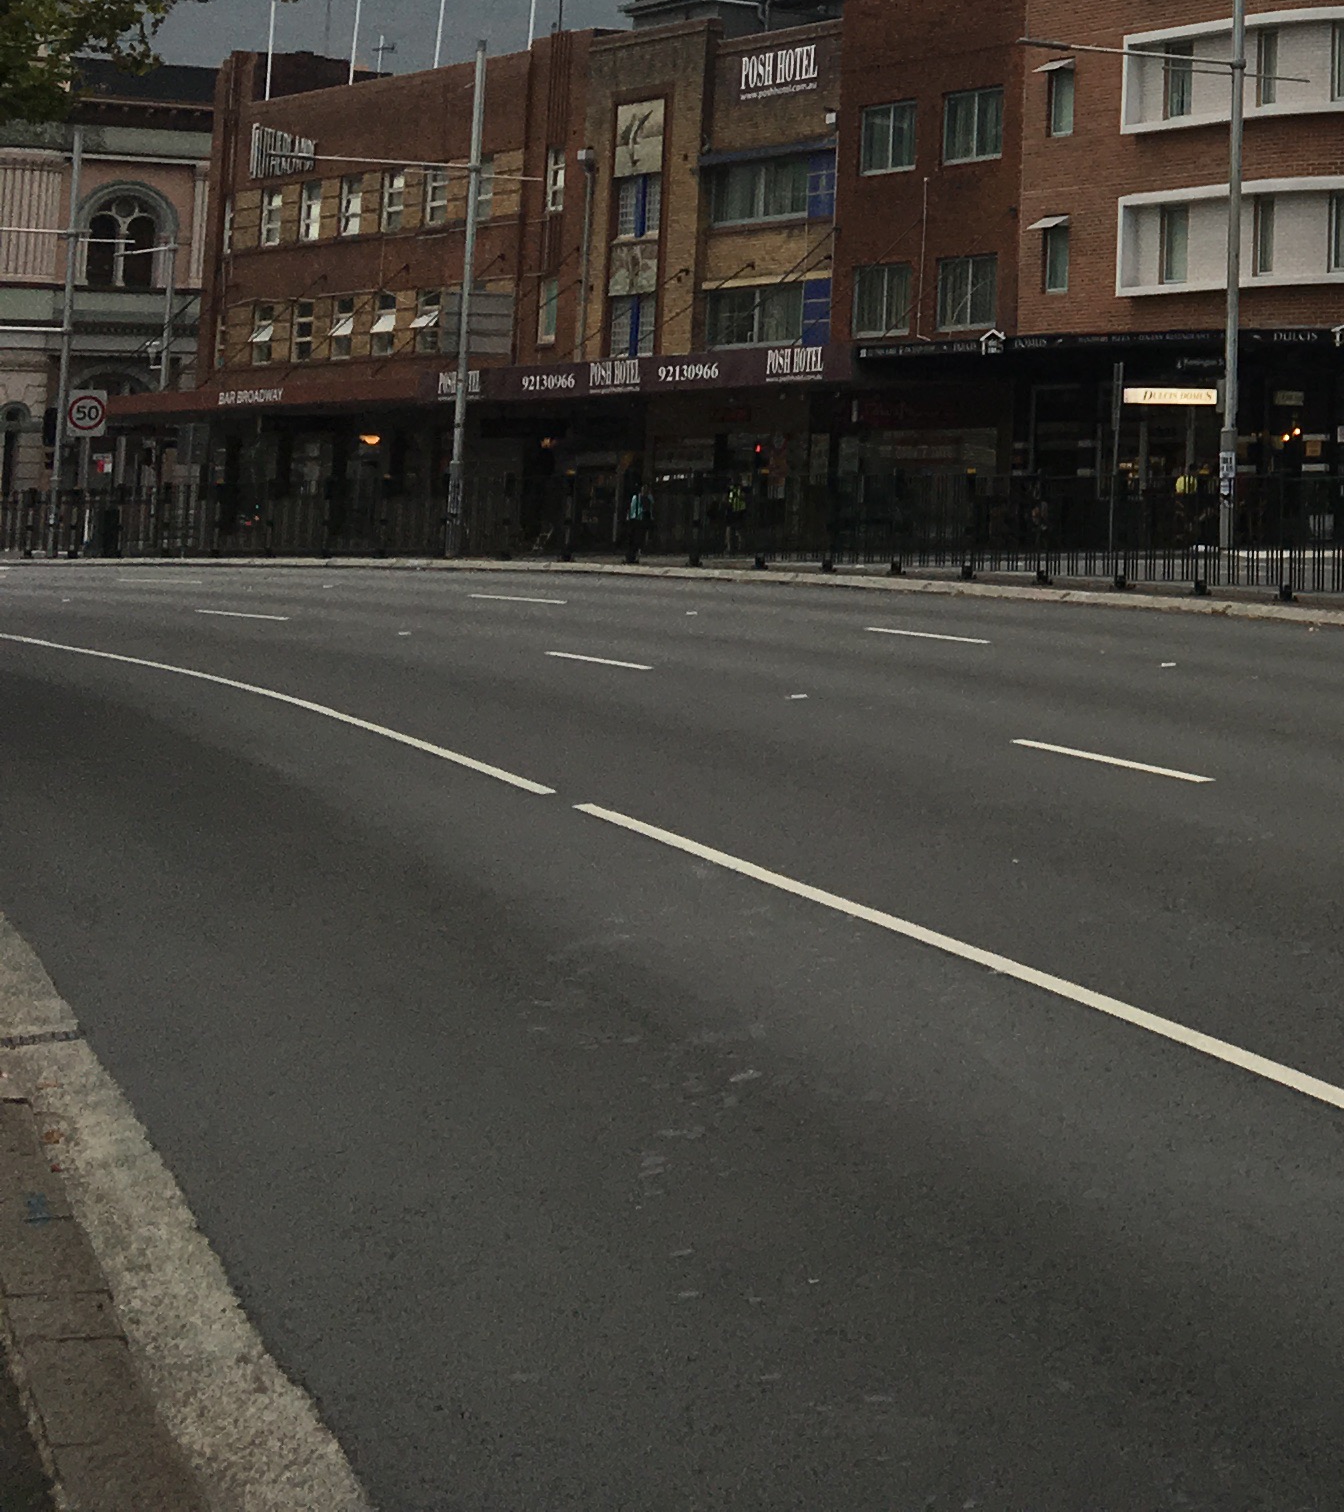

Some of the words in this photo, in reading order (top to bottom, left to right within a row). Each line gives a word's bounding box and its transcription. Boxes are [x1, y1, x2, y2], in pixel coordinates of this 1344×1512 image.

[740, 53, 774, 89] POSH
[776, 44, 818, 83] HOTEL
[767, 349, 791, 374] POSH
[793, 346, 824, 372] HOTEL
[590, 361, 612, 386] POSH
[614, 359, 640, 384] HOTEL
[658, 363, 719, 381] 92130966
[522, 373, 575, 391] 92130966
[218, 391, 236, 405] BAR
[237, 388, 284, 403] BROADWAY
[76, 406, 99, 420] 50
